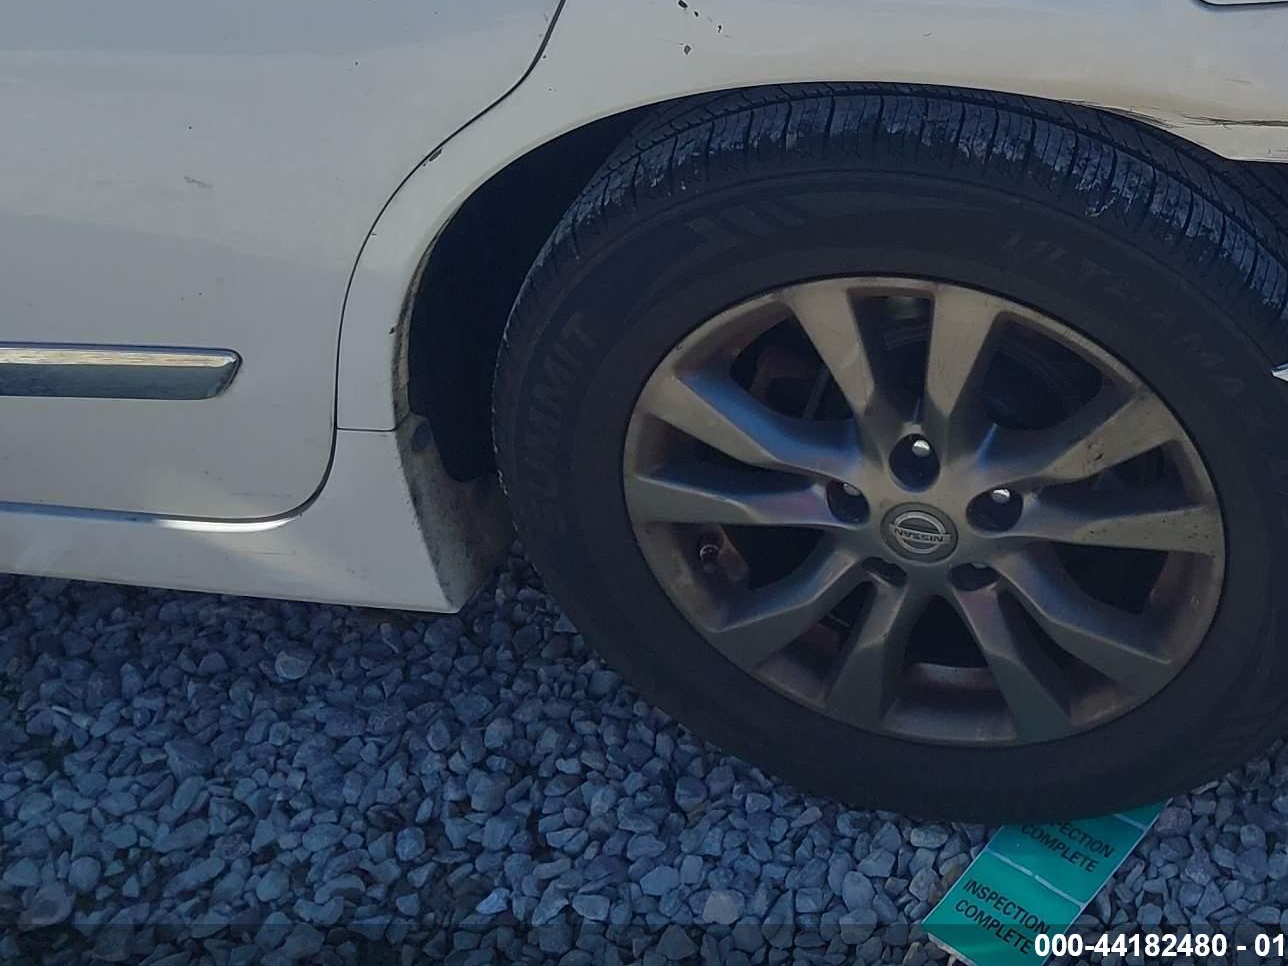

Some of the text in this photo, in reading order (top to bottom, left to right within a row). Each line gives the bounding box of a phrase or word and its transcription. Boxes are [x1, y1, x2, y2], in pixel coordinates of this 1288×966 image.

[1021, 824, 1099, 873] COMPLETE
[955, 899, 1034, 954] COMPLETE
[962, 879, 1050, 936] INSPECTION
